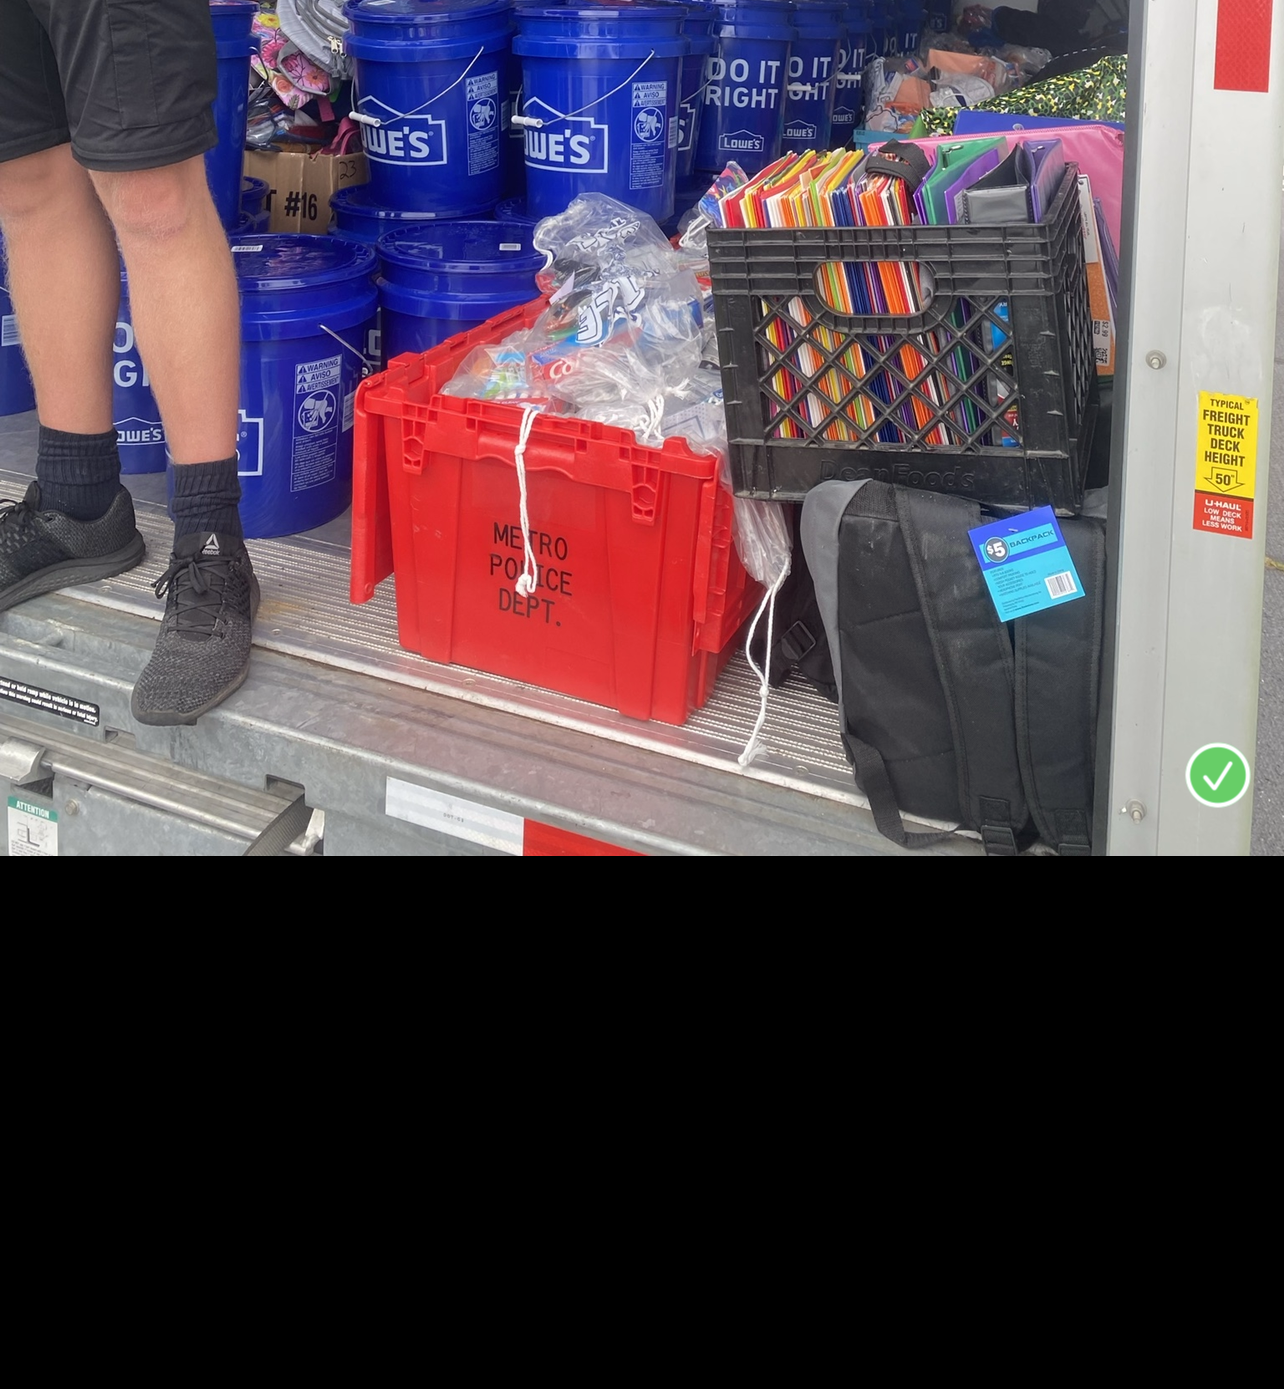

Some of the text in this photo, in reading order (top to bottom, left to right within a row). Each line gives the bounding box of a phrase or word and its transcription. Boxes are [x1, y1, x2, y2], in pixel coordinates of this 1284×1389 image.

[853, 49, 865, 68] IT
[707, 57, 781, 85] DO IT
[812, 57, 832, 79] IT
[640, 82, 665, 91] WARNING
[643, 91, 660, 99] AVISO
[705, 85, 779, 109] RIGHT
[724, 138, 761, 150] LOWE'S
[339, 160, 357, 180] 23
[284, 191, 318, 221] #16
[307, 358, 339, 372] WARNING
[310, 370, 331, 382] AVISO
[1210, 398, 1245, 411] TYPICAL
[1203, 409, 1251, 426] FREIGHT
[1207, 423, 1245, 440] TRUCK
[1210, 437, 1240, 453] DECK
[1204, 451, 1245, 467] HEIGHT
[820, 459, 975, 487] Dean Foods
[1204, 507, 1241, 519] LOW DECK
[1205, 498, 1241, 511] U-HAUL
[1202, 520, 1243, 532] LESS WORK
[1210, 515, 1235, 525] MEANS
[493, 521, 568, 561] METRO
[1009, 529, 1054, 549] BACKPACK
[987, 541, 1006, 558] $5
[498, 587, 561, 627] DEPT.
[16, 800, 50, 819] ATTENTION
